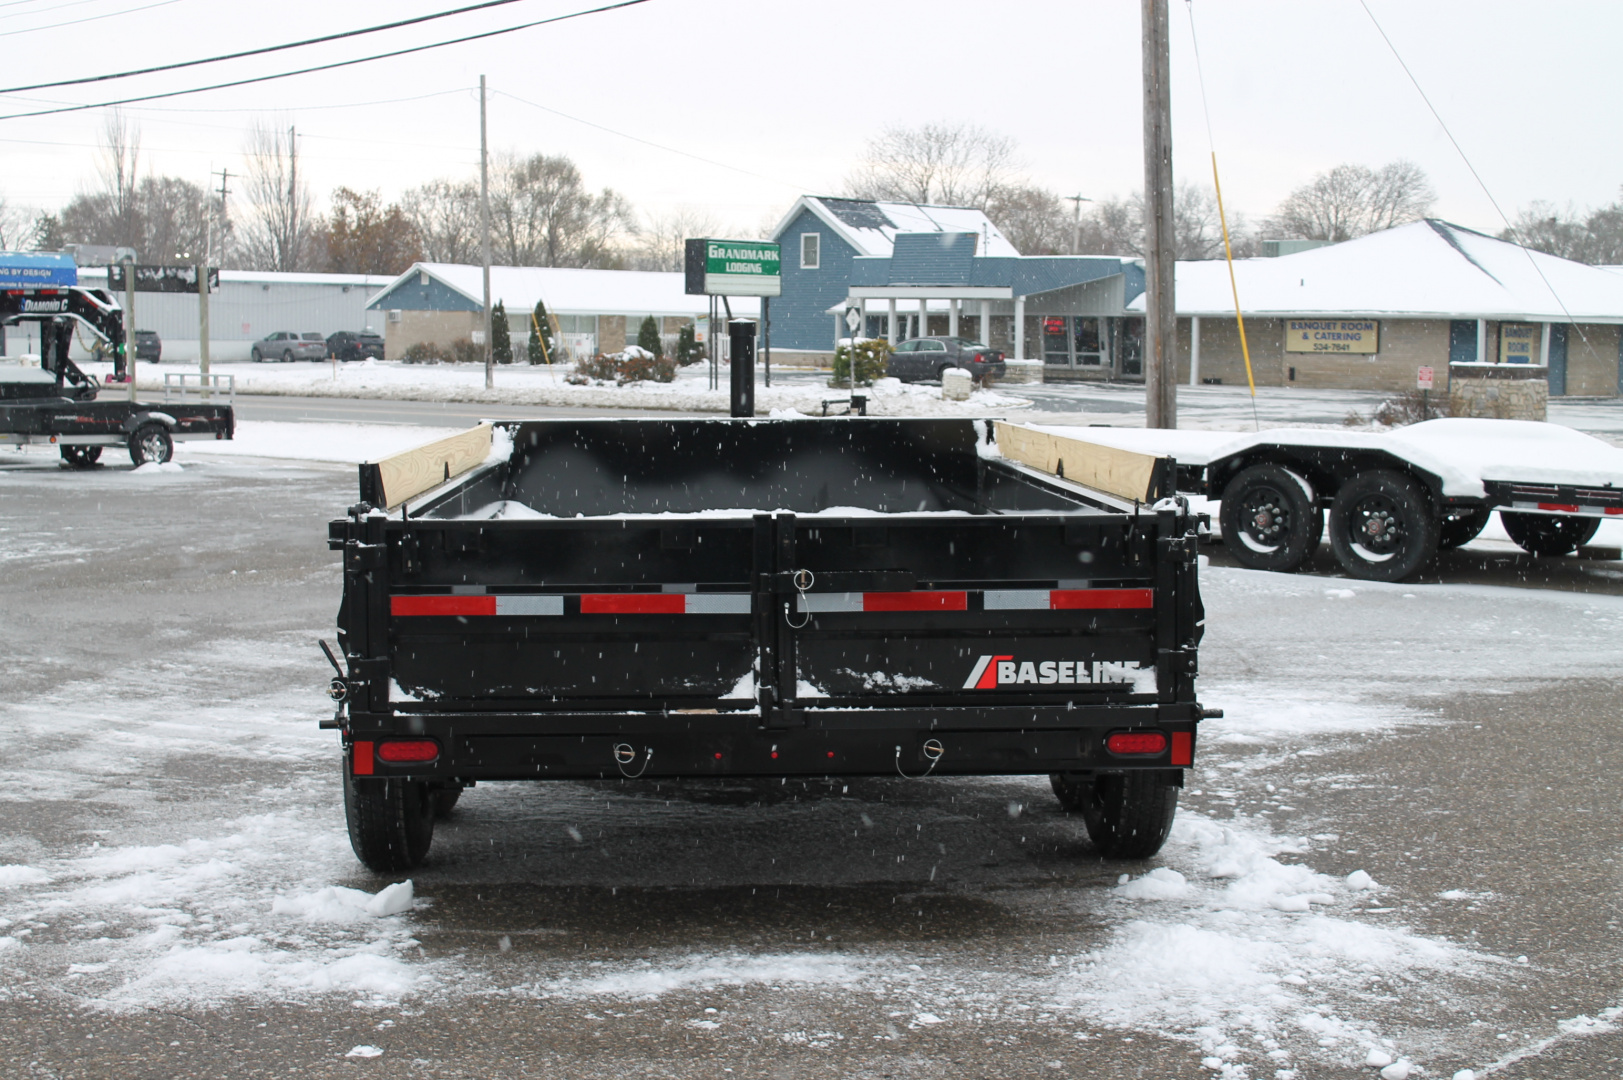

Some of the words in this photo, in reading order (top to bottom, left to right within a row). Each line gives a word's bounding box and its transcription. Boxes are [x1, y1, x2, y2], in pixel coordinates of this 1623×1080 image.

[708, 245, 779, 261] GRANDMARK
[11, 268, 21, 276] BY
[23, 268, 52, 277] DESIGN
[726, 262, 762, 273] LODGING
[24, 299, 60, 311] DIAMOND
[61, 299, 69, 311] C
[1291, 321, 1337, 330] BANQUET
[1341, 322, 1373, 331] ROOM
[1302, 332, 1309, 340] &
[1314, 332, 1362, 341] CATERING
[1505, 327, 1533, 338] BANQUET
